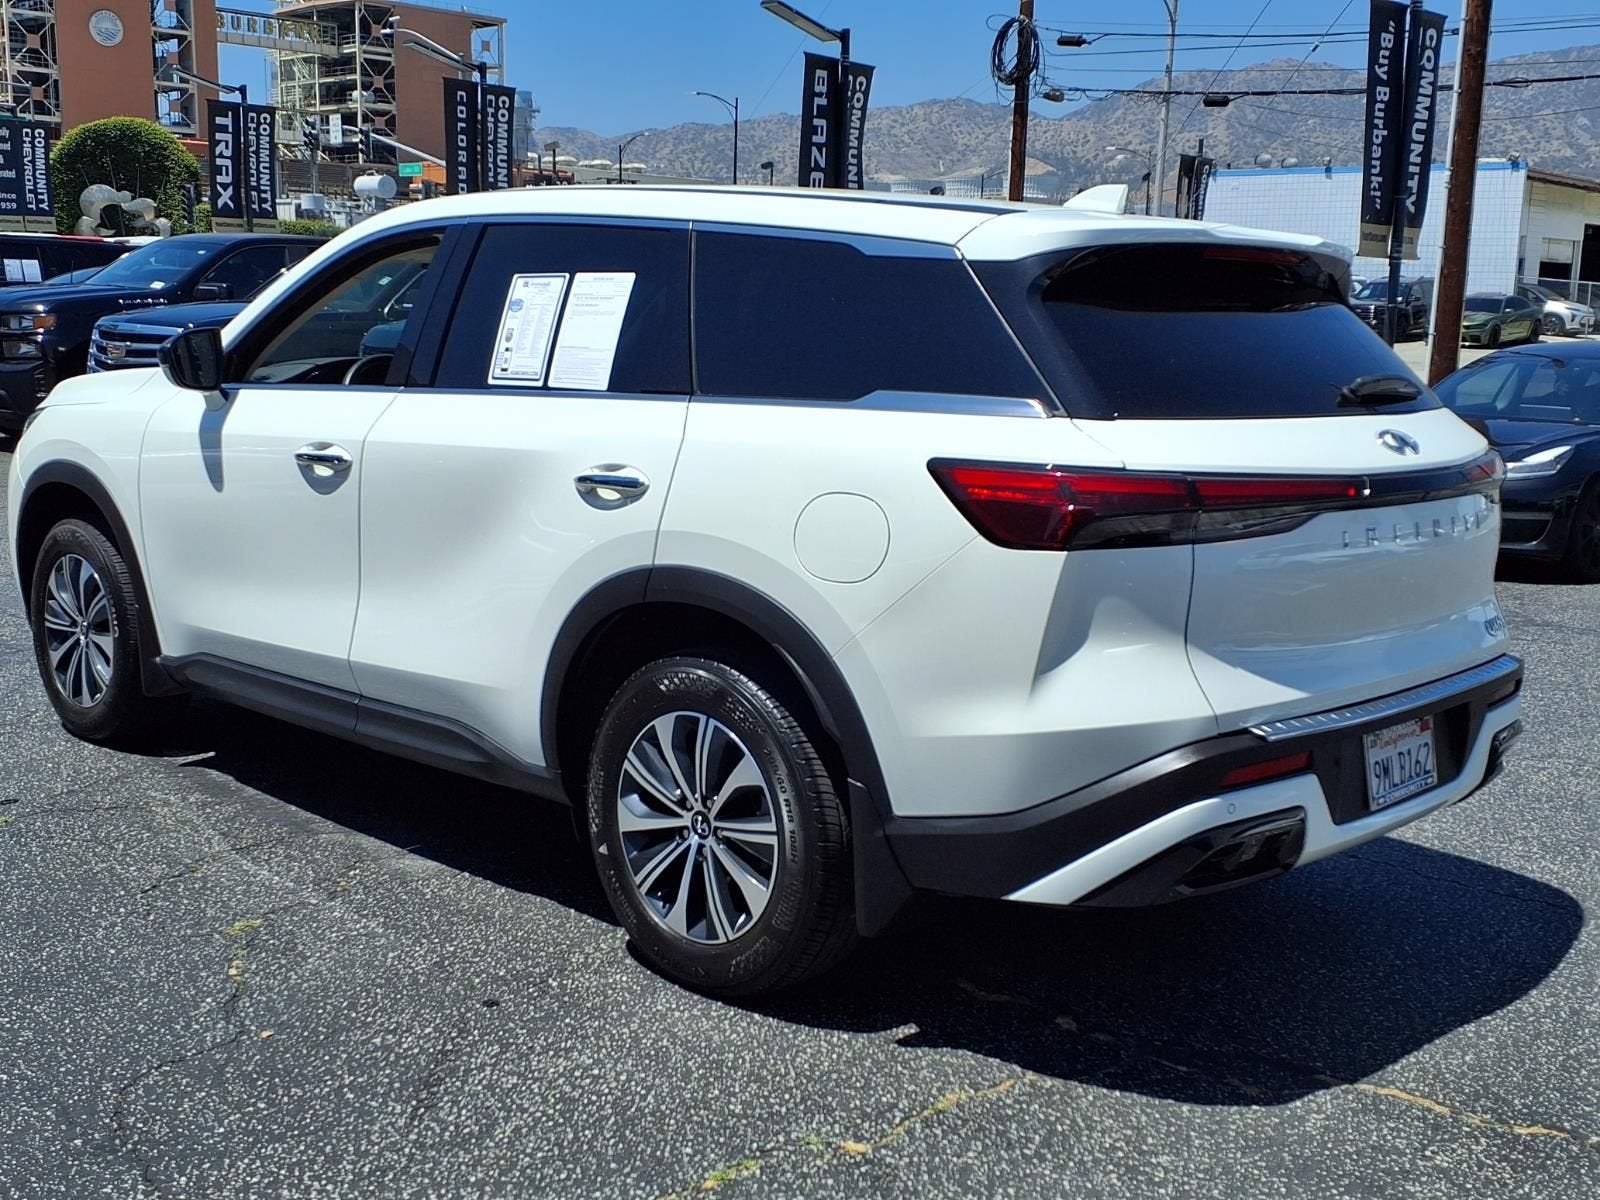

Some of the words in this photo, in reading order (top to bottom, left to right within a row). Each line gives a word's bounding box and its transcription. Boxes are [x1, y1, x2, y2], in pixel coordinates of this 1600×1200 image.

[216, 11, 321, 43] BURBANK
[22, 128, 36, 211] CHEVROLET
[34, 128, 49, 211] COMMUNITY
[215, 111, 235, 210] TRAX
[259, 113, 273, 212] COMMUNITY
[457, 90, 468, 194] COLORAD
[496, 95, 510, 188] COMMUNI
[810, 69, 828, 188] BLAZE
[848, 76, 867, 188] COMMUNI
[1405, 27, 1438, 214] COMMUNITY
